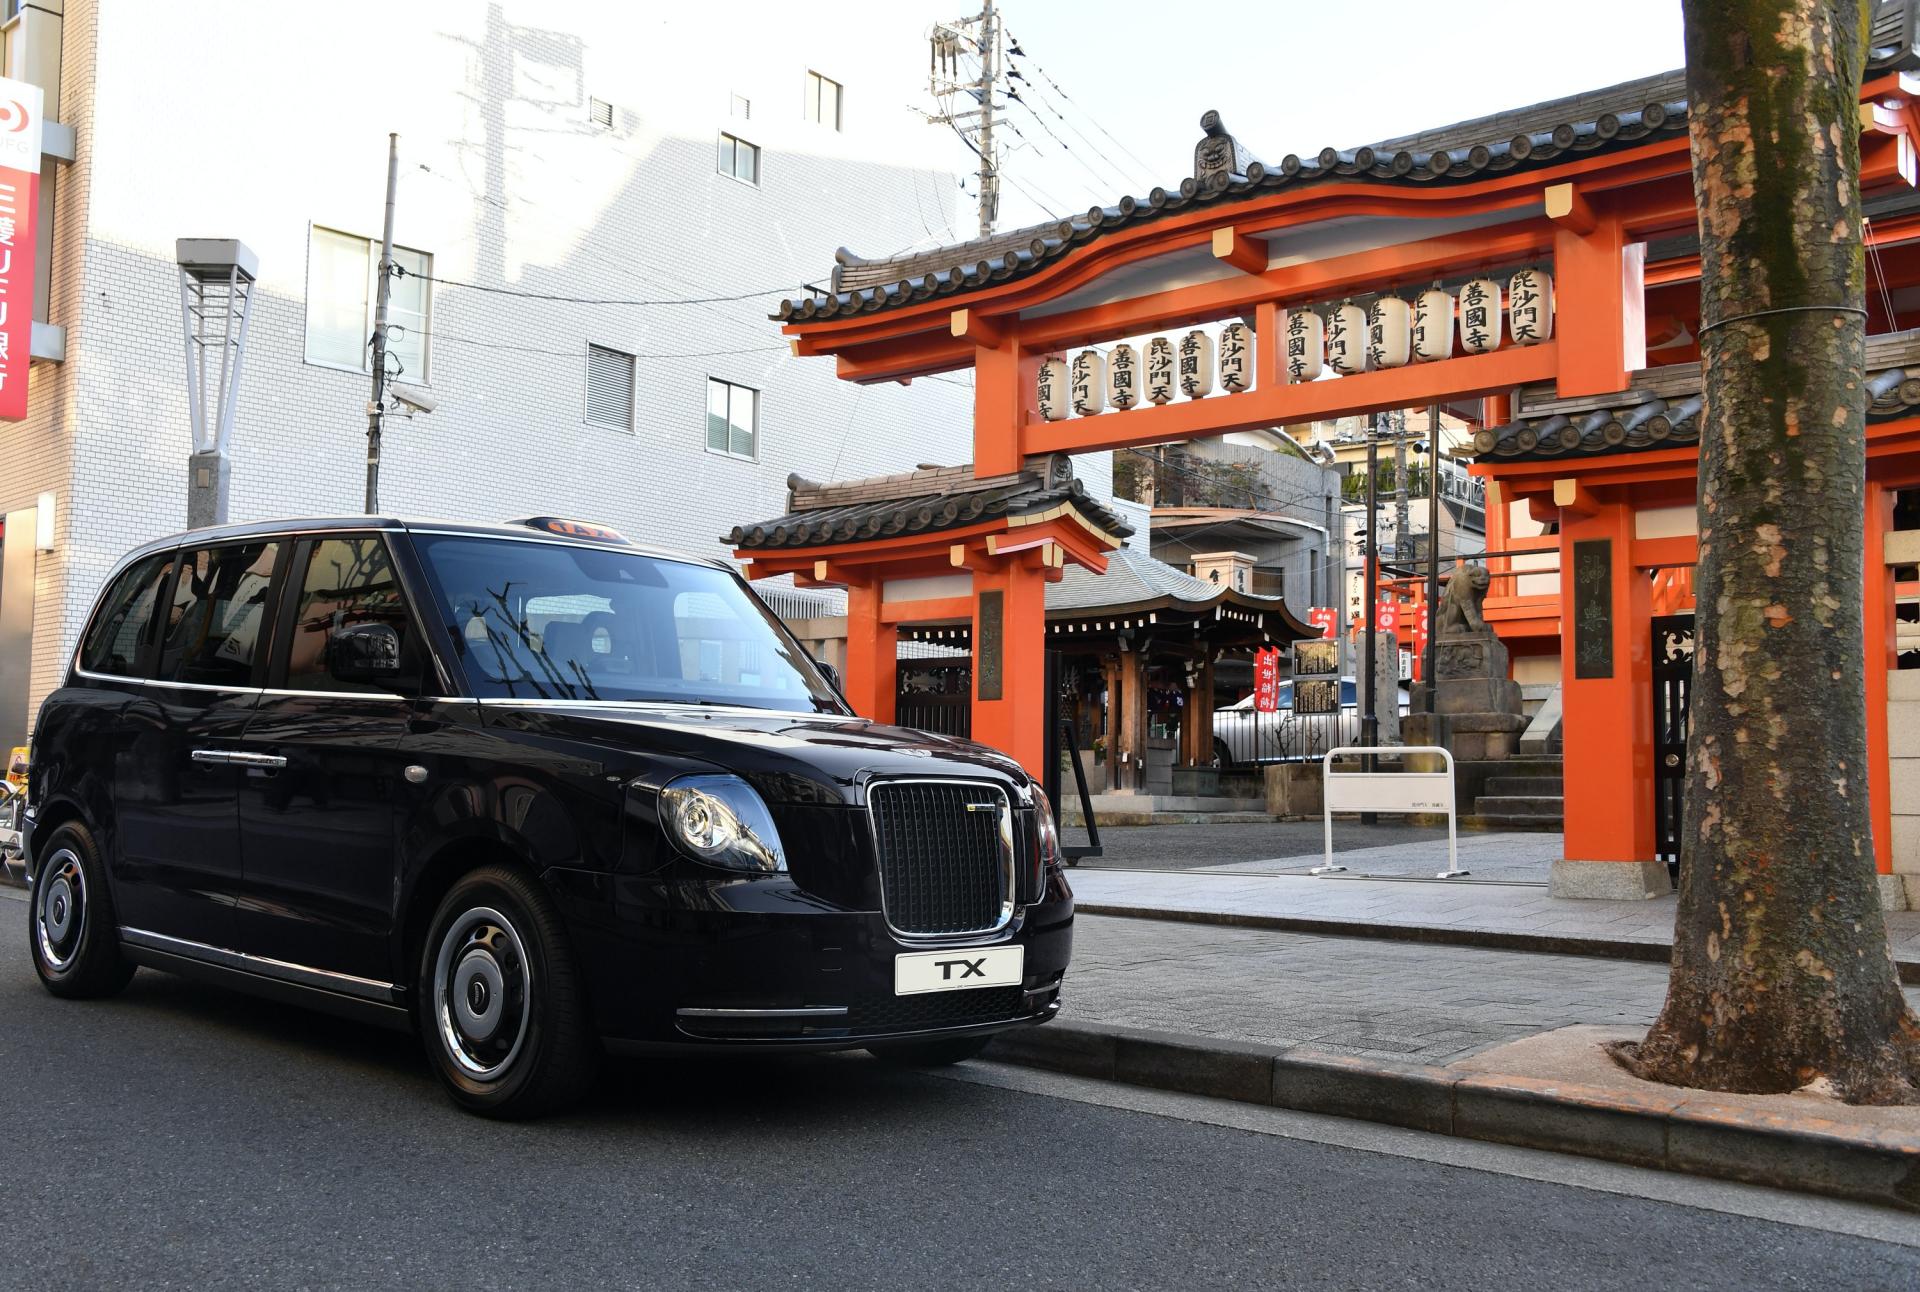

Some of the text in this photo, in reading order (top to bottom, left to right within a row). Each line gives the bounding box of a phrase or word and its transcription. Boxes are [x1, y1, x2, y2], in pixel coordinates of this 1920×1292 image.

[1463, 282, 1489, 348] 善國寺
[1512, 271, 1542, 341] 毘沙門天
[1149, 341, 1173, 400] 毘沙門天
[1179, 334, 1201, 394] 善國寺
[1220, 326, 1245, 388] 毘沙門天
[1287, 313, 1309, 377] 善國寺
[1112, 349, 1134, 405] 善國寺
[935, 957, 987, 980] TX
